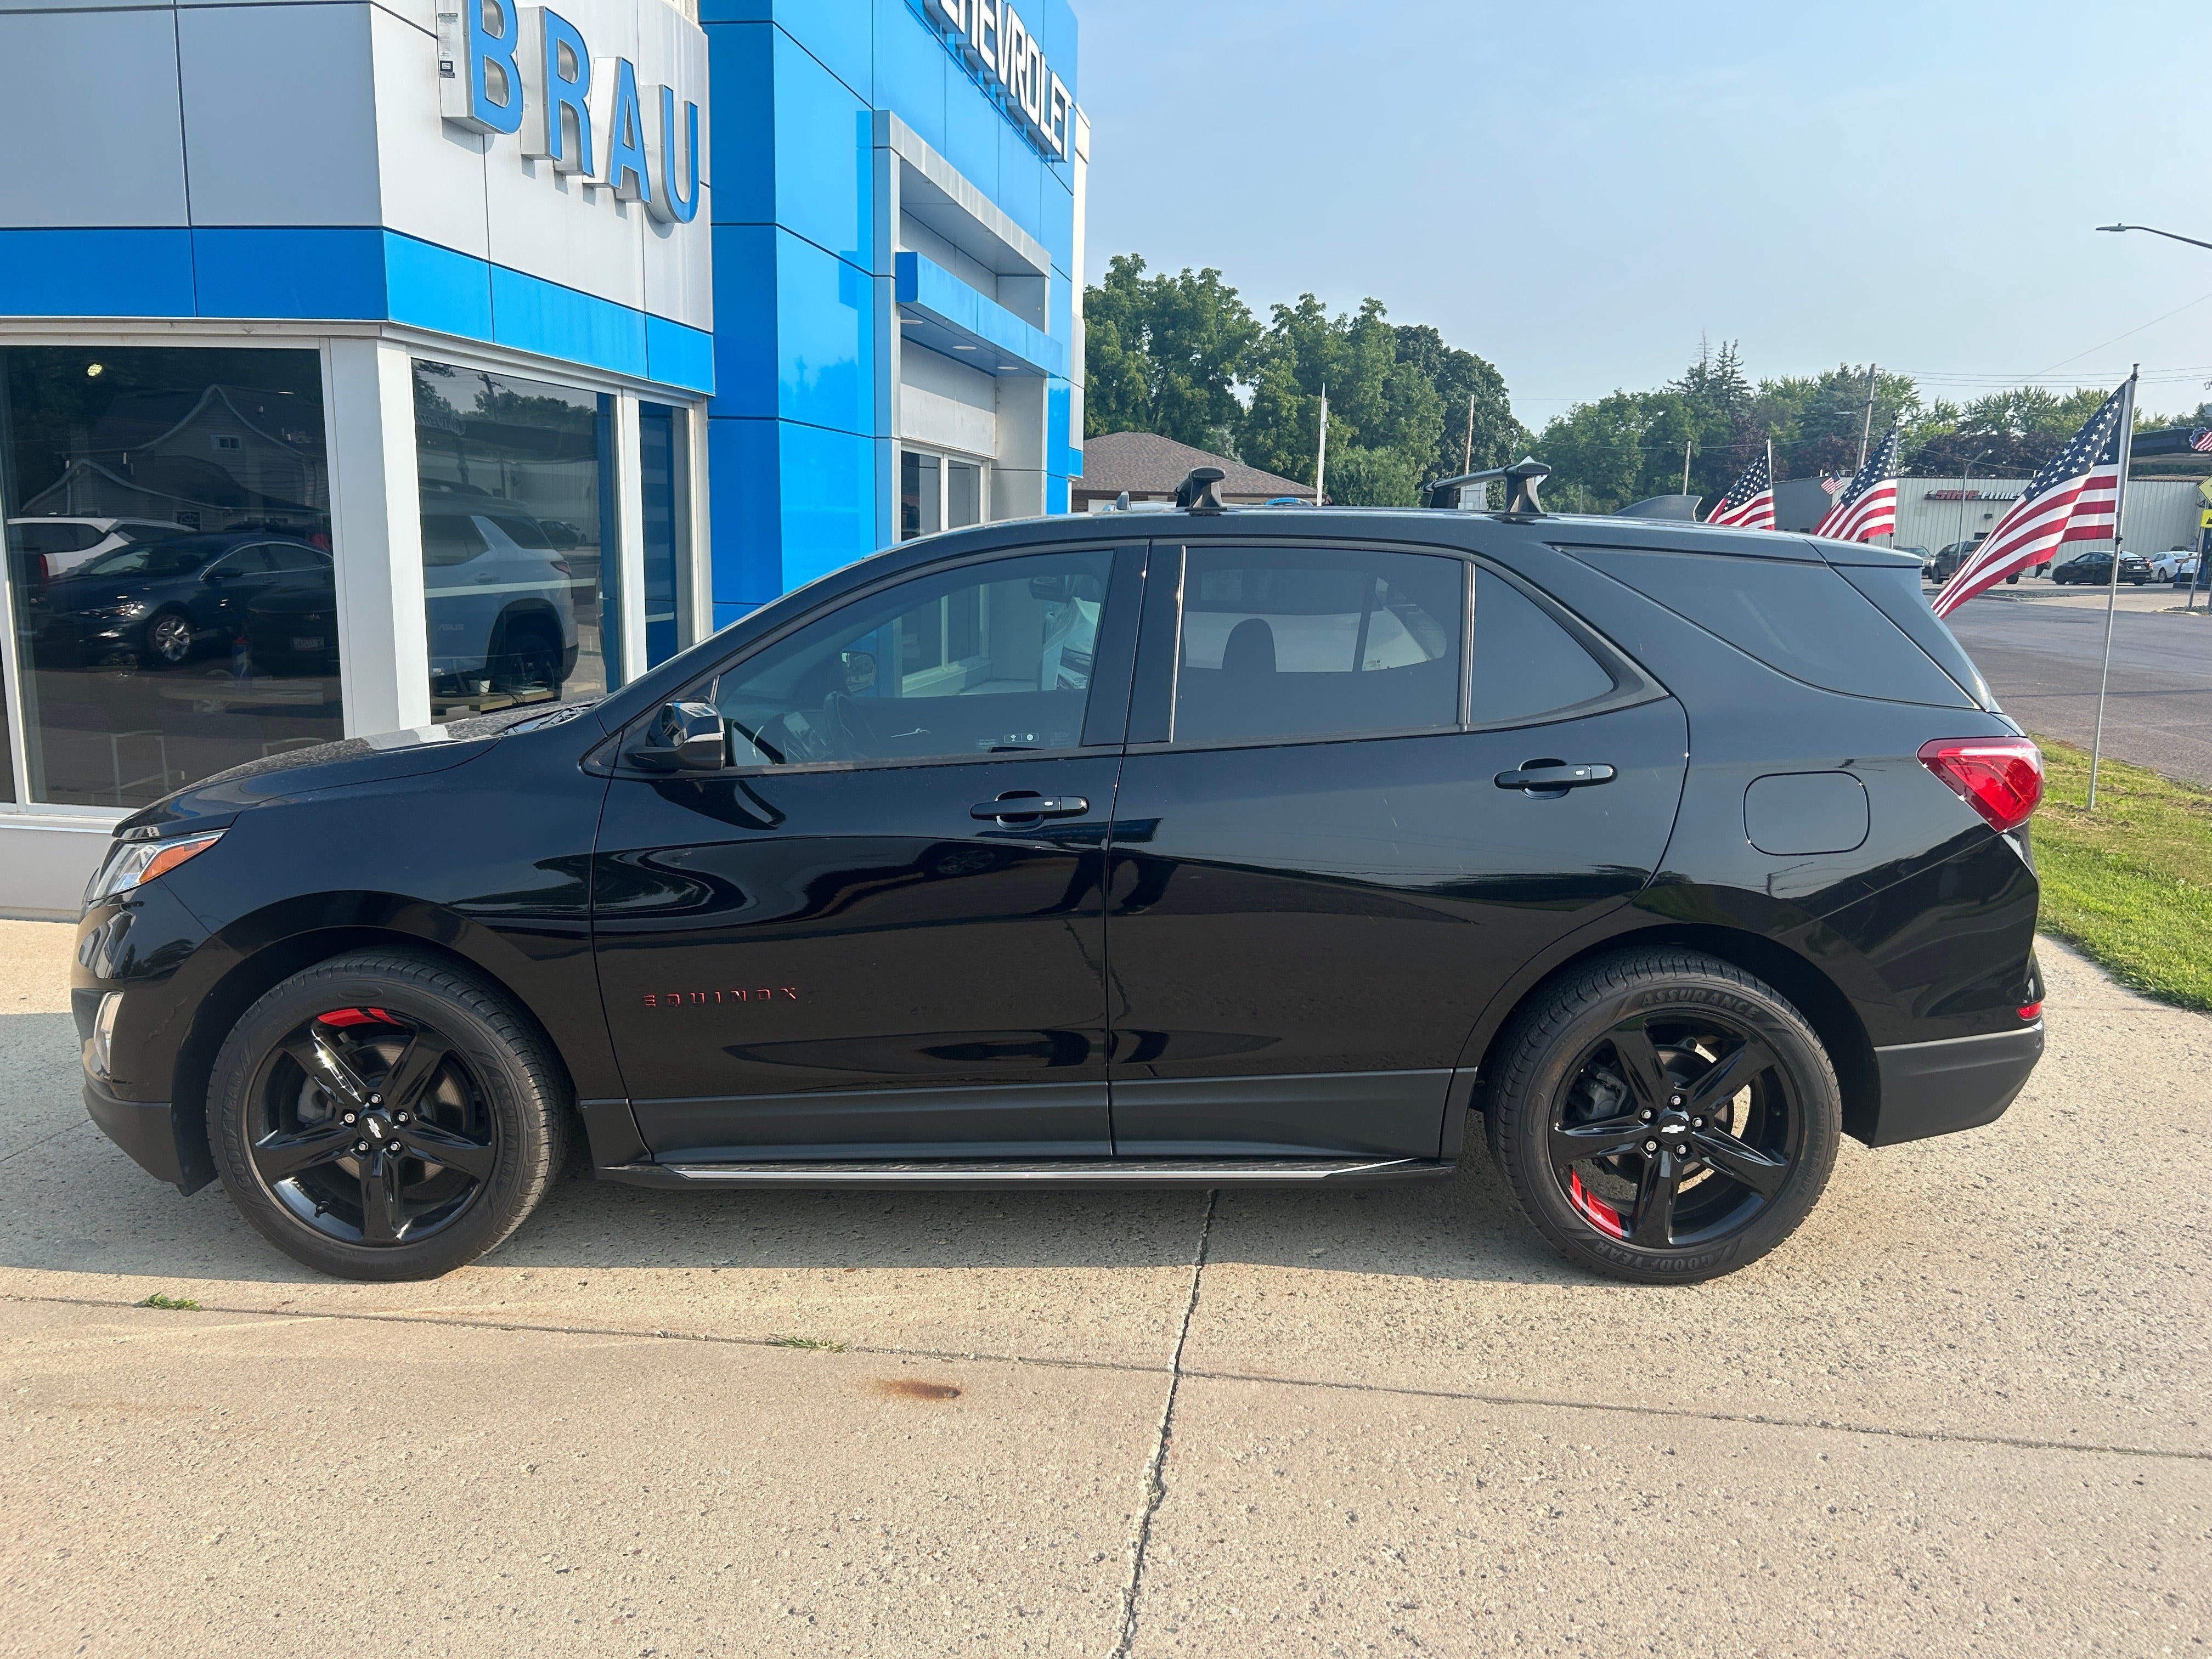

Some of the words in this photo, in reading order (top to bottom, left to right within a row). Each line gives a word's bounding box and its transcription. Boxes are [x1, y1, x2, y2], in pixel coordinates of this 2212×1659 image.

[940, 0, 1072, 163] EVROLET
[469, 0, 699, 224] BRAU
[642, 987, 797, 1007] EQUINOX
[1642, 989, 1760, 1018] ASSURANCE
[1594, 1240, 1713, 1272] GOODYEAR
